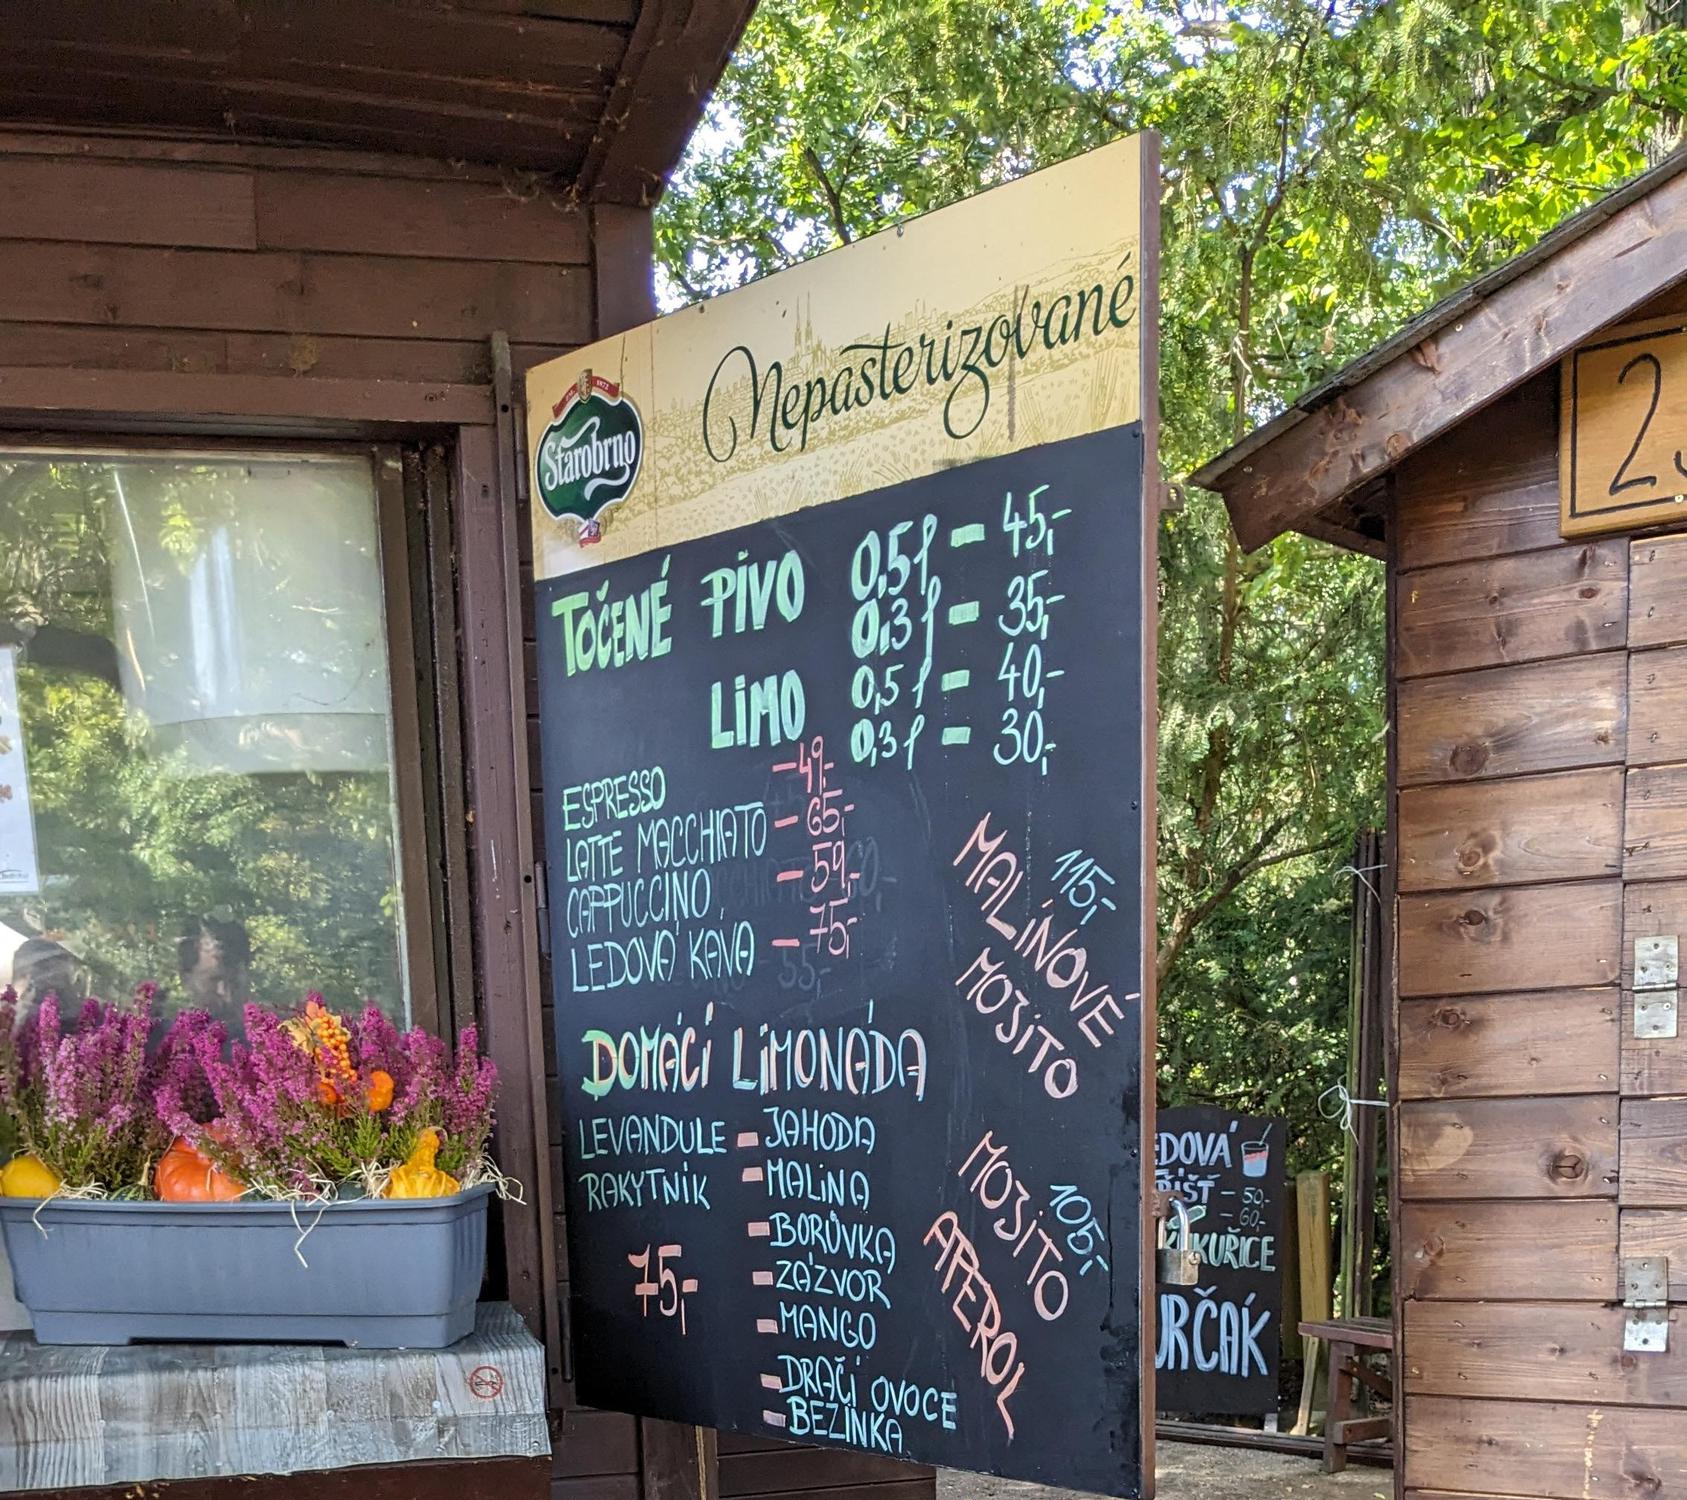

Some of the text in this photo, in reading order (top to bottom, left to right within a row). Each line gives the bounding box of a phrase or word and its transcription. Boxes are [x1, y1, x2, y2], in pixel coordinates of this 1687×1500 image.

[703, 252, 1136, 462] Nepasterizované
[545, 416, 636, 501] Starobrno
[1609, 353, 1687, 497] 2
[551, 554, 672, 677] TOČENÉ
[563, 766, 666, 831] ESPRESSO
[567, 830, 623, 883] LATTE
[638, 801, 767, 873] MACCHIATO
[567, 868, 711, 938] CAPPUCCINO
[571, 920, 680, 992] LEDOVÁ
[689, 907, 755, 980] KÁVA
[581, 1001, 713, 1101] DOMÁCÍ
[955, 947, 1079, 1099] MOJITO
[579, 1113, 727, 1159] LEVANDULE
[763, 1106, 875, 1154] JAHODA
[1155, 1120, 1238, 1168] DOVÁ
[769, 1210, 896, 1274] BORŮVKA
[776, 1252, 892, 1309] ZÁZVOR
[779, 1301, 876, 1350] MANGO
[923, 1210, 1025, 1440] APEROL
[777, 1355, 957, 1430] DRAČÍ OVOCE
